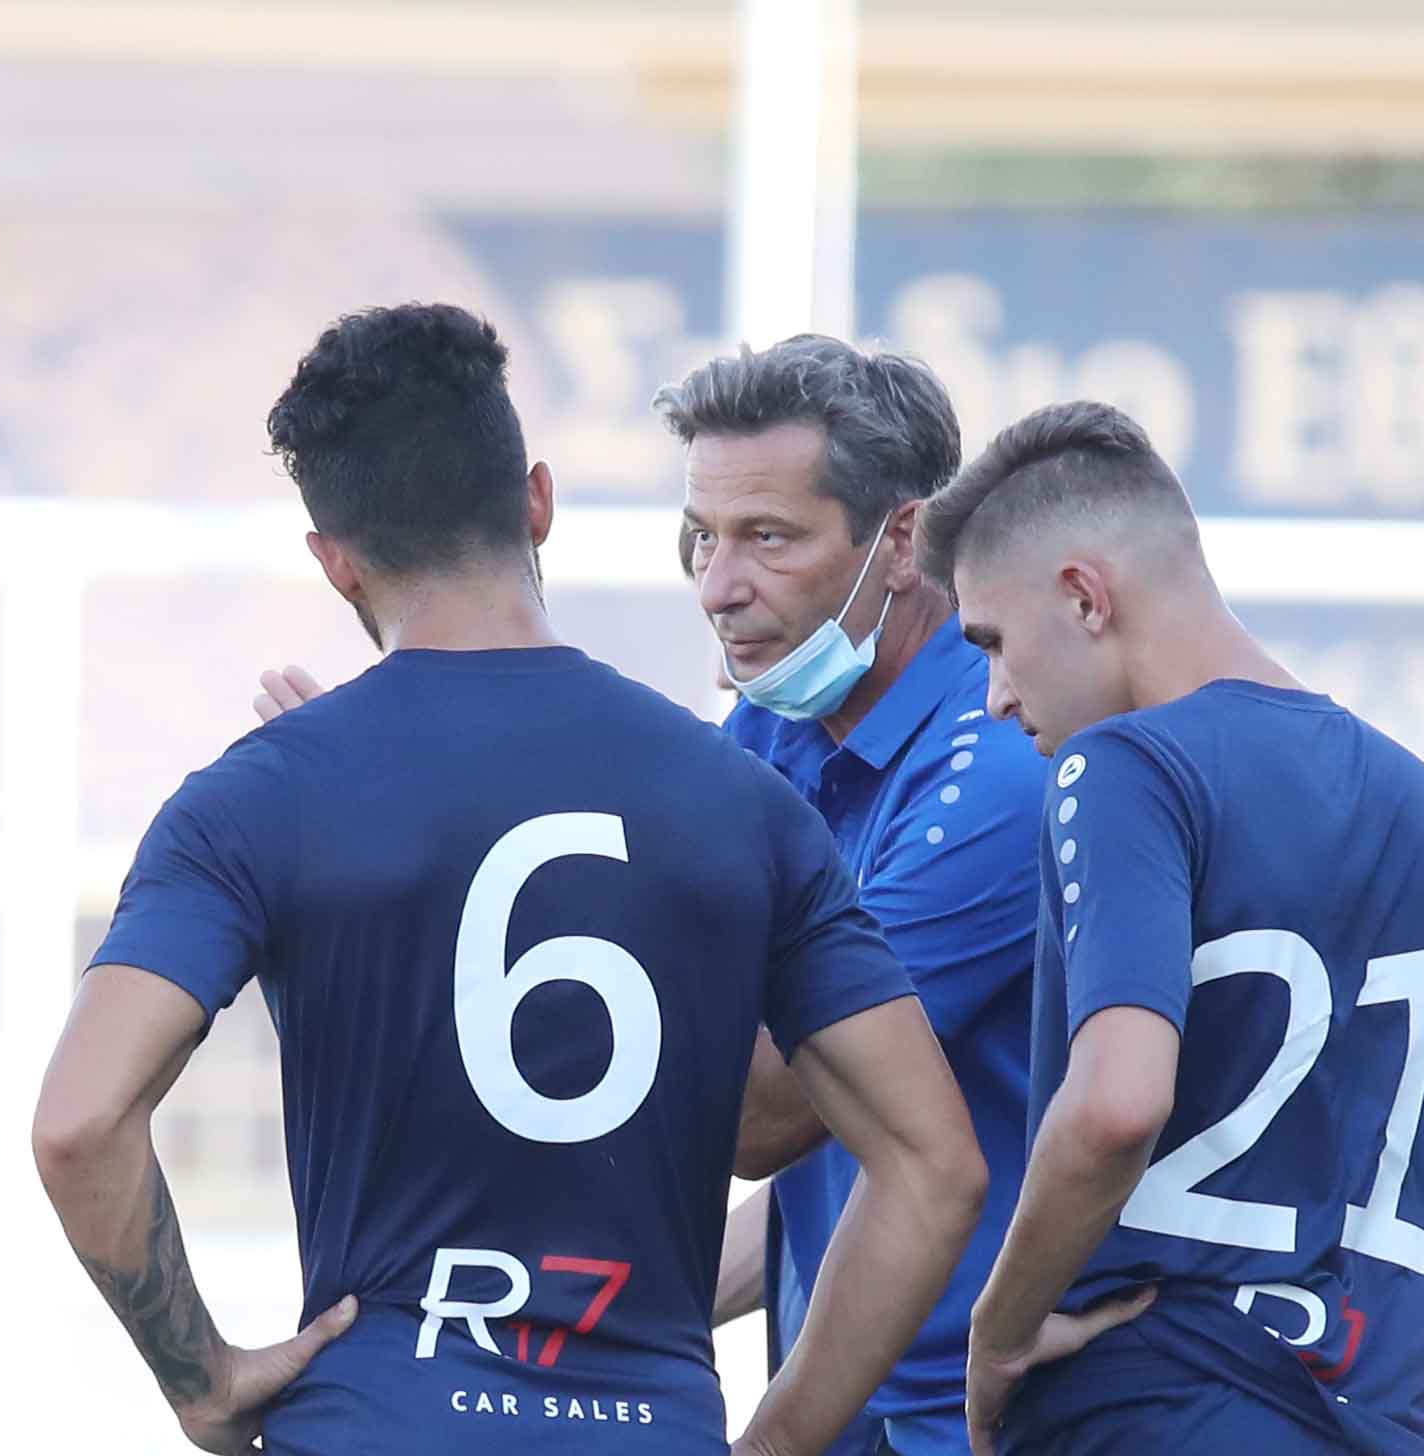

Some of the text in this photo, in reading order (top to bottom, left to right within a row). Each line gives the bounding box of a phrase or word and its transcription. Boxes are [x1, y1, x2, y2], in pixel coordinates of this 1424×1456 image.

[453, 811, 662, 1143] 6
[451, 1390, 653, 1424] CAR SALES
